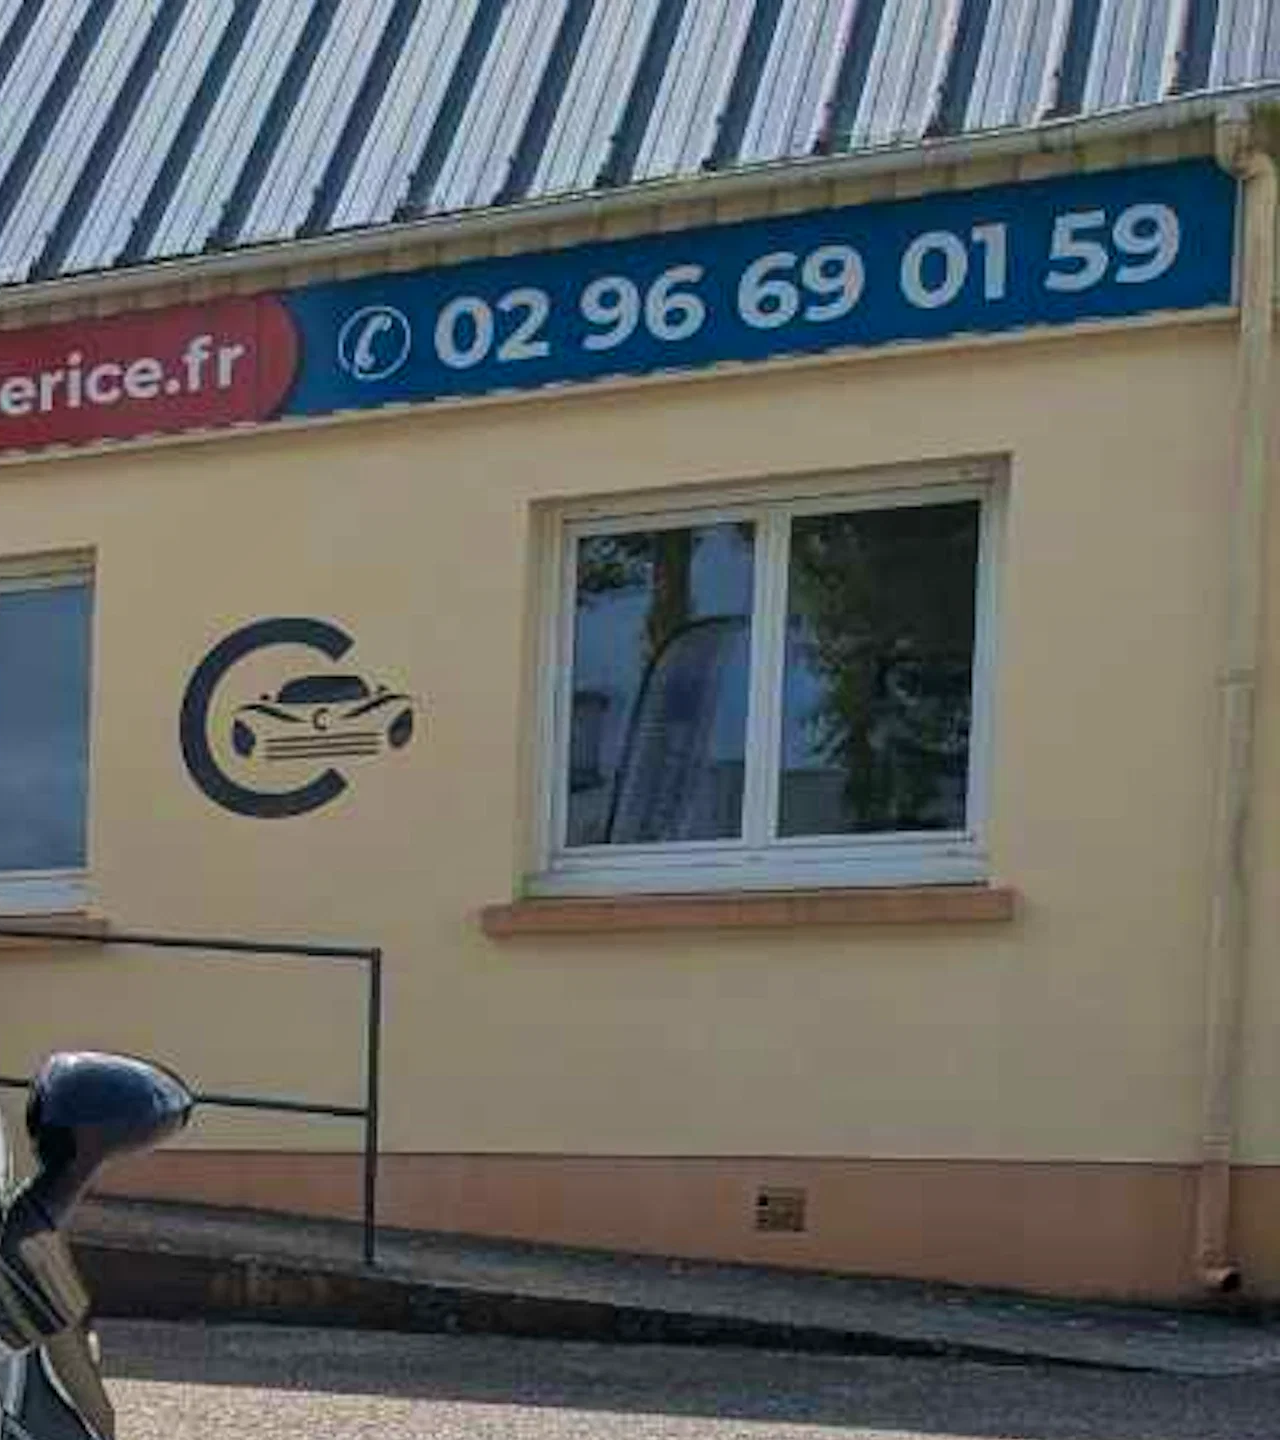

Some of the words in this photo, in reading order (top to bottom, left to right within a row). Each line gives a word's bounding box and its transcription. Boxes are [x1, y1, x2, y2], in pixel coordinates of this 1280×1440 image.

[434, 288, 551, 370] 02
[580, 263, 707, 352] 96
[737, 244, 866, 328] 69
[900, 222, 1008, 309] 01
[1045, 203, 1182, 292] 59
